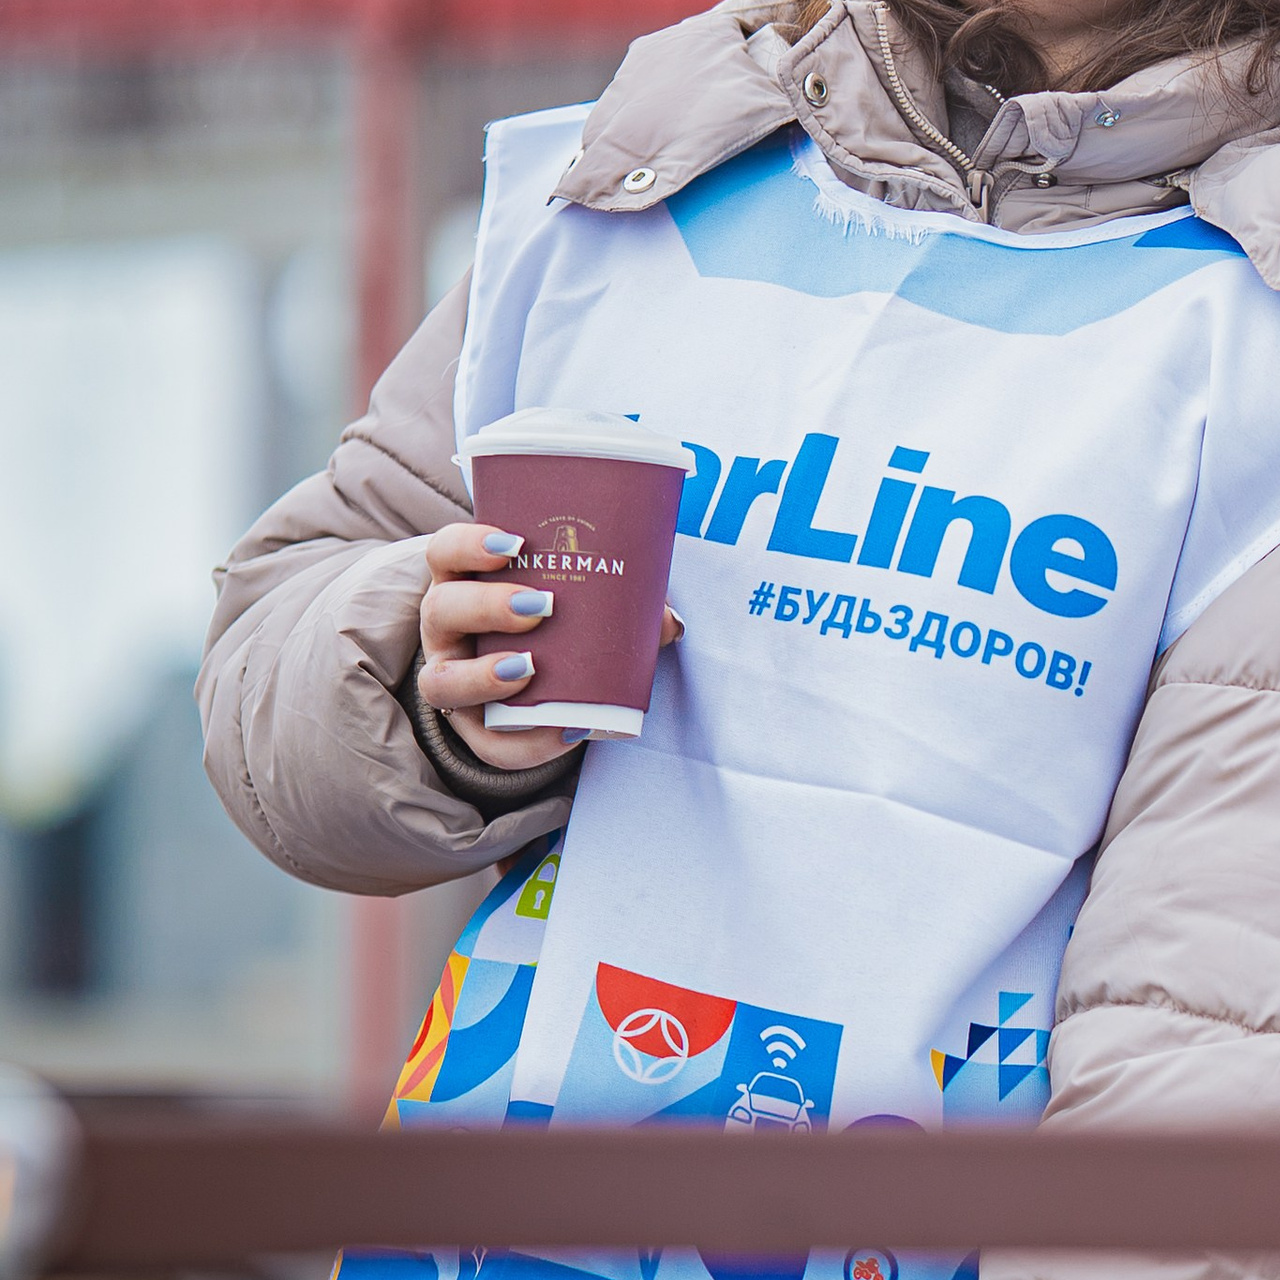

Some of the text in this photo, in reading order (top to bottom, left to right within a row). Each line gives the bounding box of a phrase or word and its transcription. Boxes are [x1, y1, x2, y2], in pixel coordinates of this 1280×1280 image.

[624, 414, 1118, 618] arLine
[541, 573, 567, 581] SINCE
[749, 581, 1092, 697] #БУДЬЗДОРОВ!
